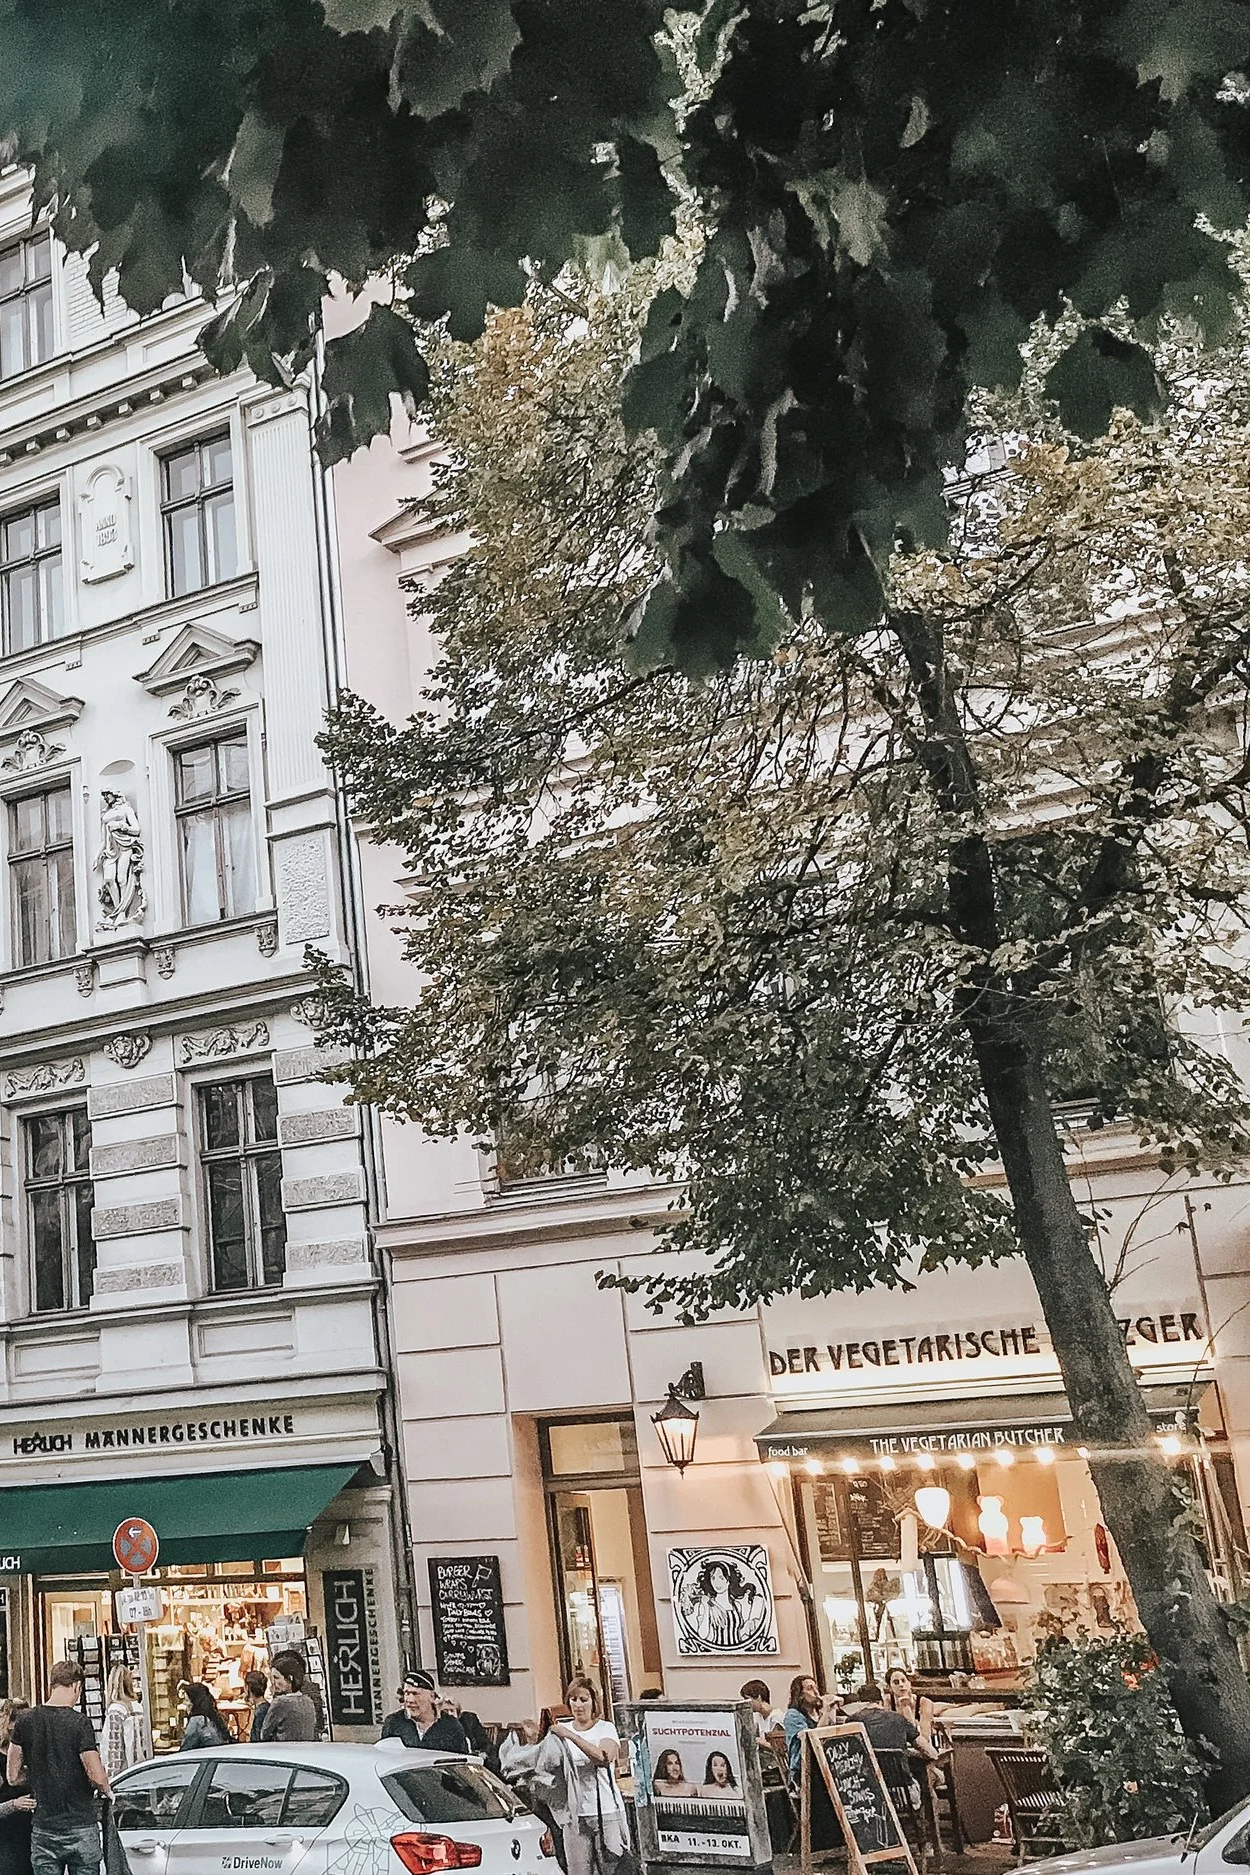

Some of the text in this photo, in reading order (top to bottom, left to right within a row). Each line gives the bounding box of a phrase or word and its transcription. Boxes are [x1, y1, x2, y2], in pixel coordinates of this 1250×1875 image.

[768, 1346, 821, 1377] DER
[826, 1326, 1042, 1371] VEGETARISCHE
[85, 1415, 295, 1450] MÄNNERGESCHENKE
[1155, 1421, 1187, 1433] store
[869, 1426, 1066, 1455] THE VEGETARIAN BUTCHER
[767, 1445, 809, 1459] food bar
[437, 1565, 473, 1580] BURGER
[439, 1578, 468, 1591] WRAPS
[651, 1727, 732, 1738] SUCHTPOTENZIAL
[233, 1856, 283, 1869] DriveNow
